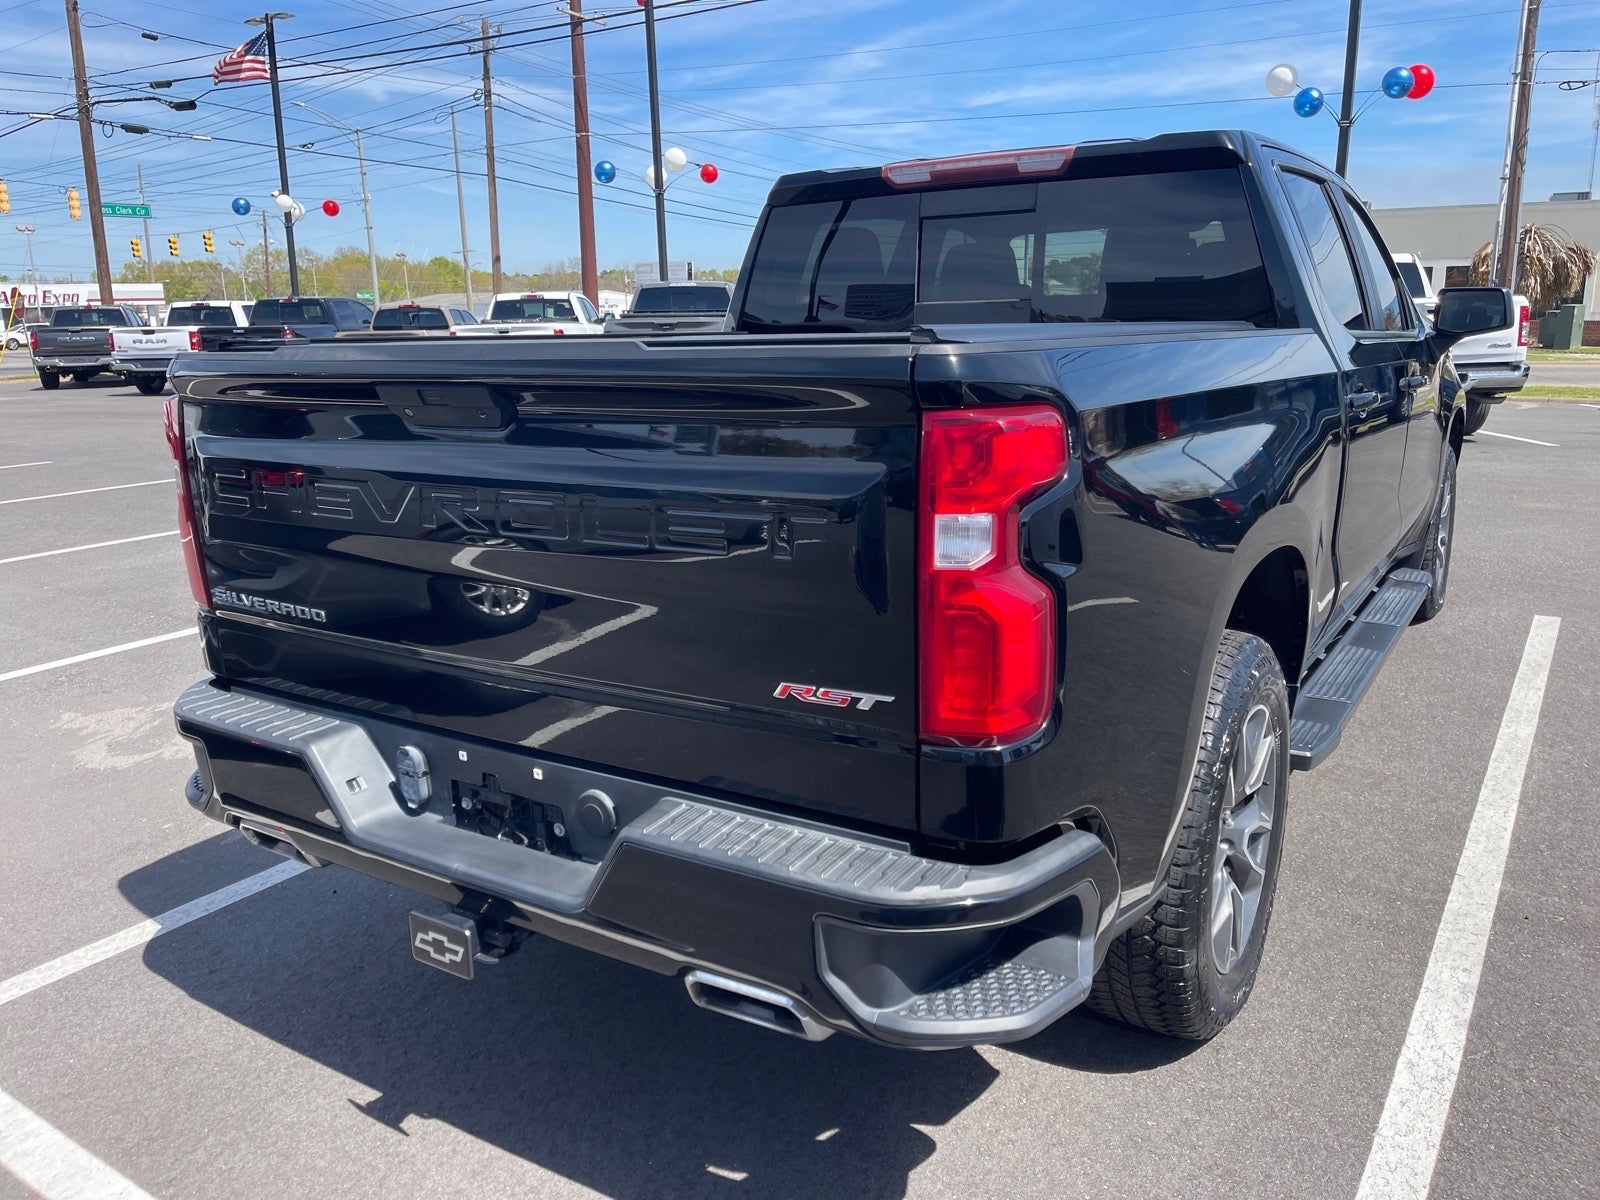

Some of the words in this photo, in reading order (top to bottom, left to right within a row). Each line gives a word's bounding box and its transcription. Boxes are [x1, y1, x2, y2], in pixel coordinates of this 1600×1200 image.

[115, 206, 133, 215] Clark
[136, 207, 145, 215] Cir
[209, 466, 829, 561] CHEVROLET
[210, 585, 327, 622] SILVERADO
[772, 681, 896, 711] RST
